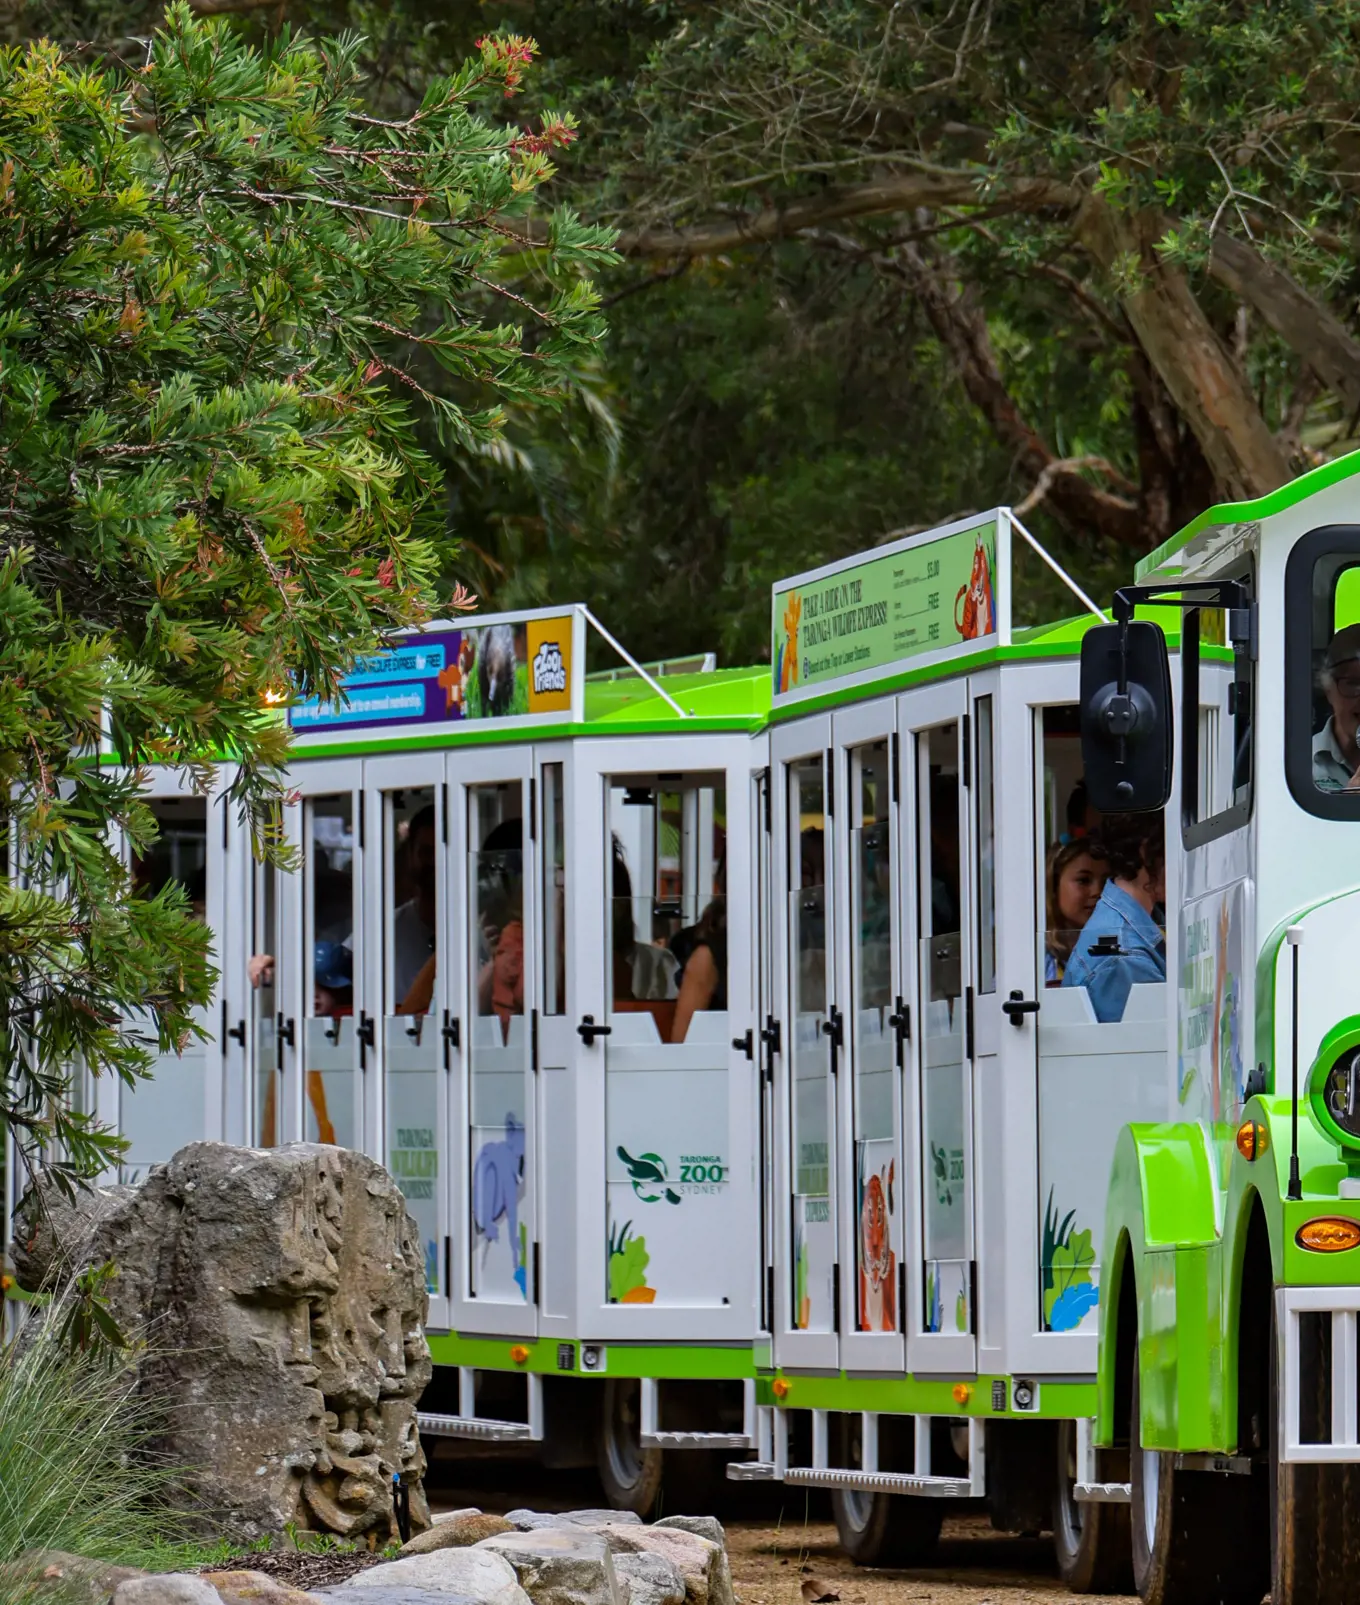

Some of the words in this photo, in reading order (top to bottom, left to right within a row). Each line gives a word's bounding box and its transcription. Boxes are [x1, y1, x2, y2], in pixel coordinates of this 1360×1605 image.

[849, 578, 862, 605] THE
[928, 591, 940, 610] FREE
[803, 618, 832, 648] TARONGA
[928, 621, 940, 641] FREE
[679, 1155, 722, 1163] TARONGA
[679, 1165, 723, 1183] ZOO
[680, 1185, 722, 1195] SYDNEY
